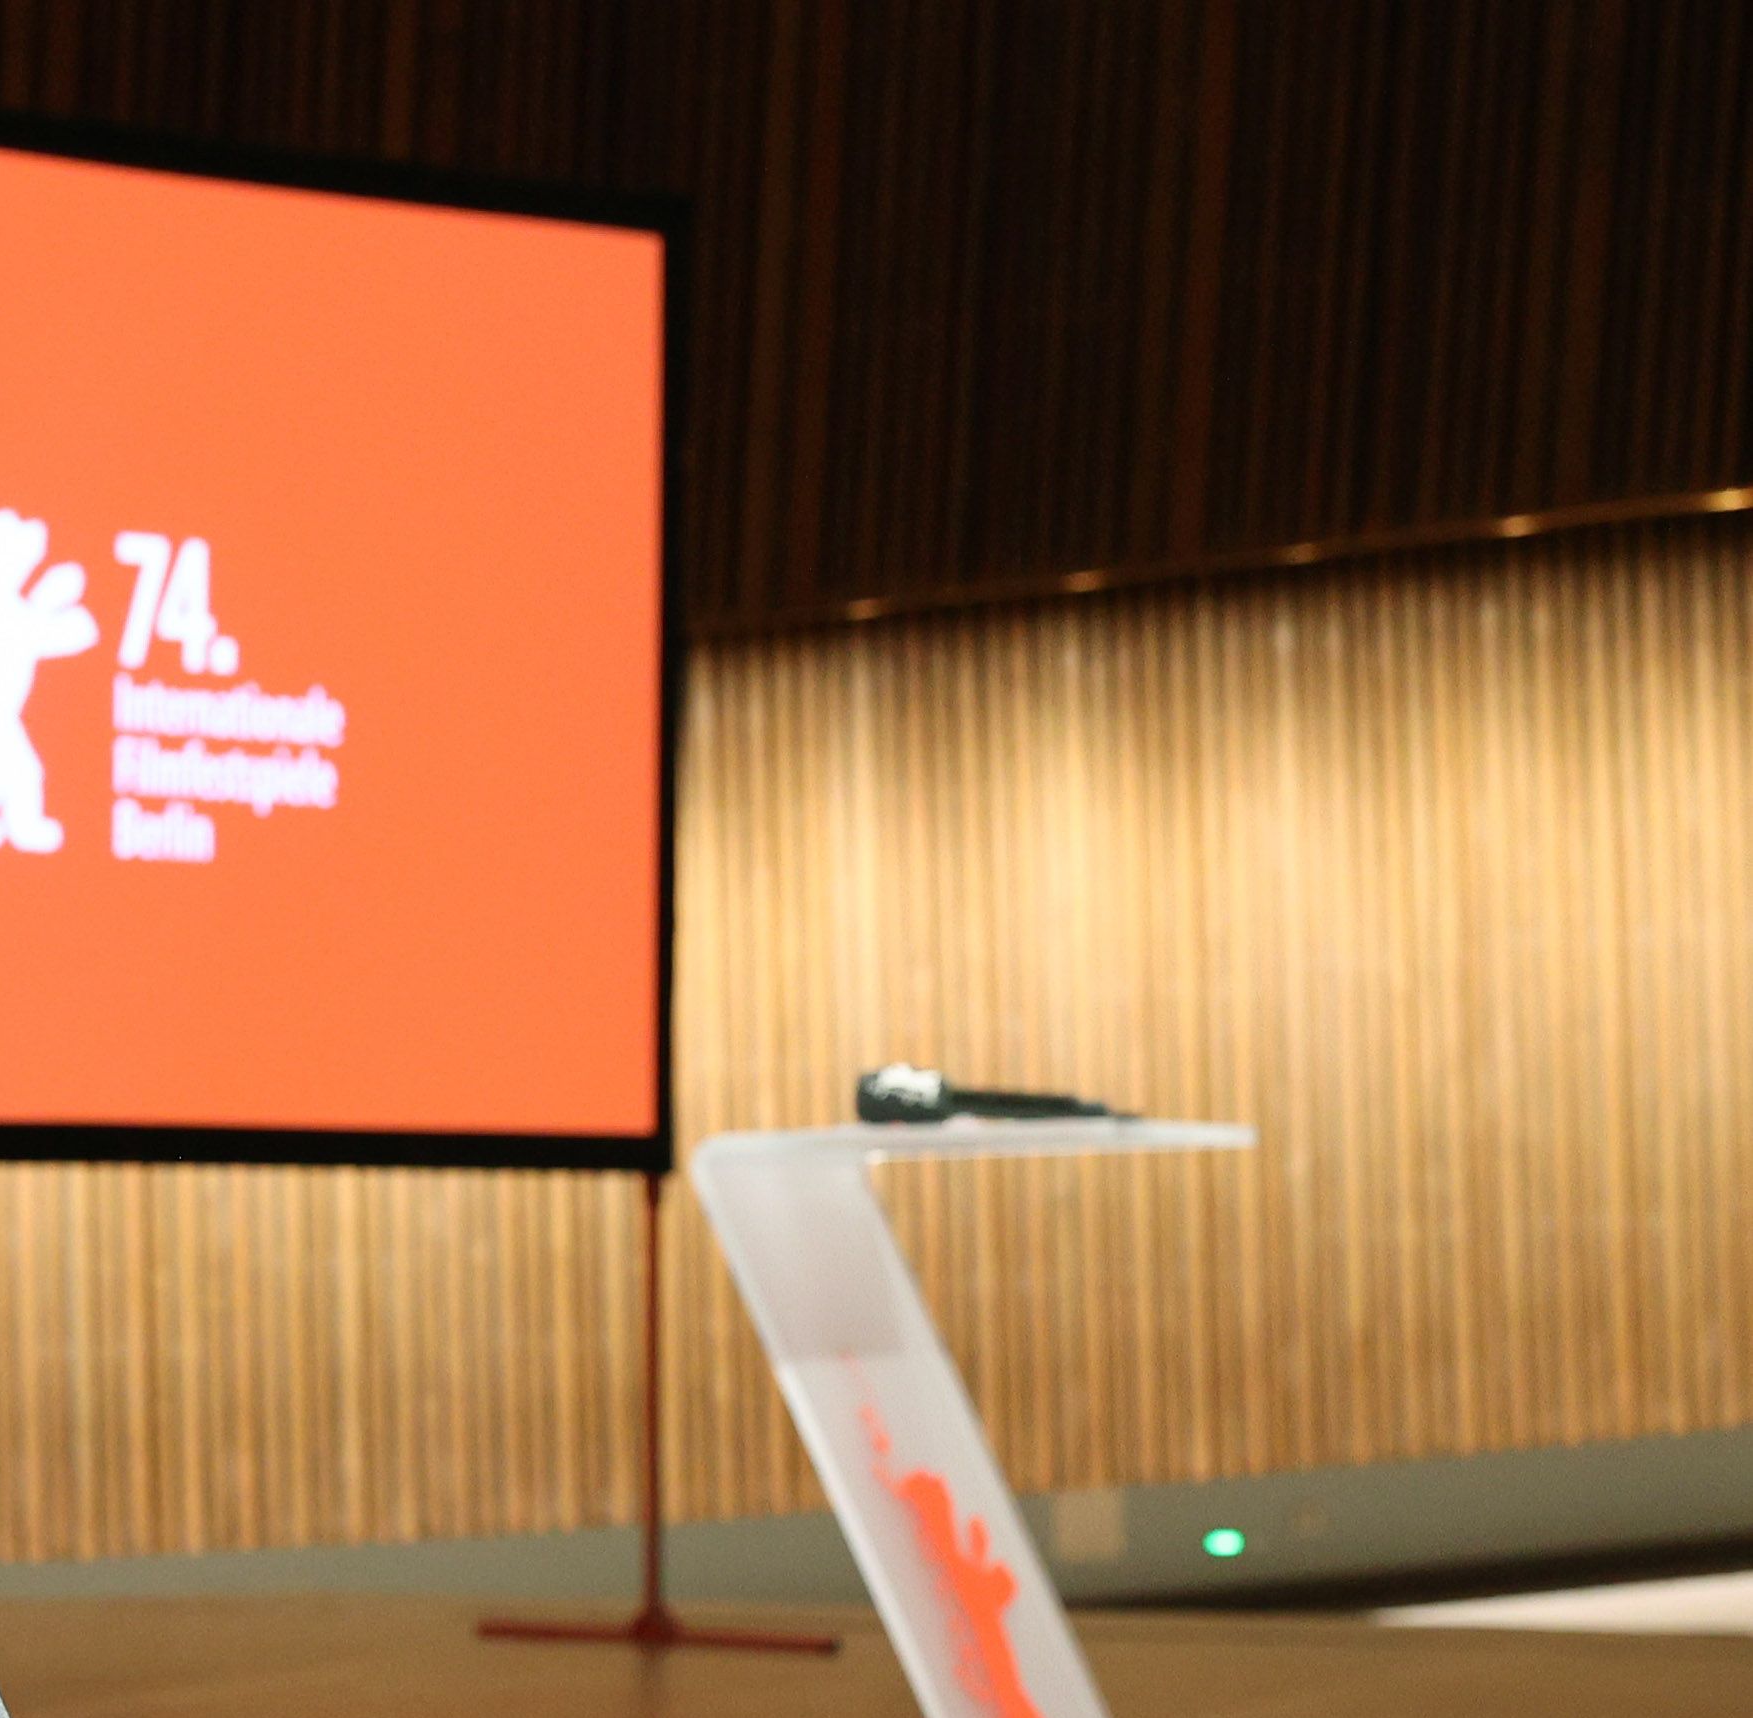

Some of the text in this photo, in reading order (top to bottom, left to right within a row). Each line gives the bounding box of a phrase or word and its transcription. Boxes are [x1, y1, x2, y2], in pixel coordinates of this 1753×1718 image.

[113, 530, 239, 676] 74.
[112, 672, 345, 748] Internationale
[112, 734, 338, 819] Filmfestspiele
[111, 797, 216, 863] Berlin
